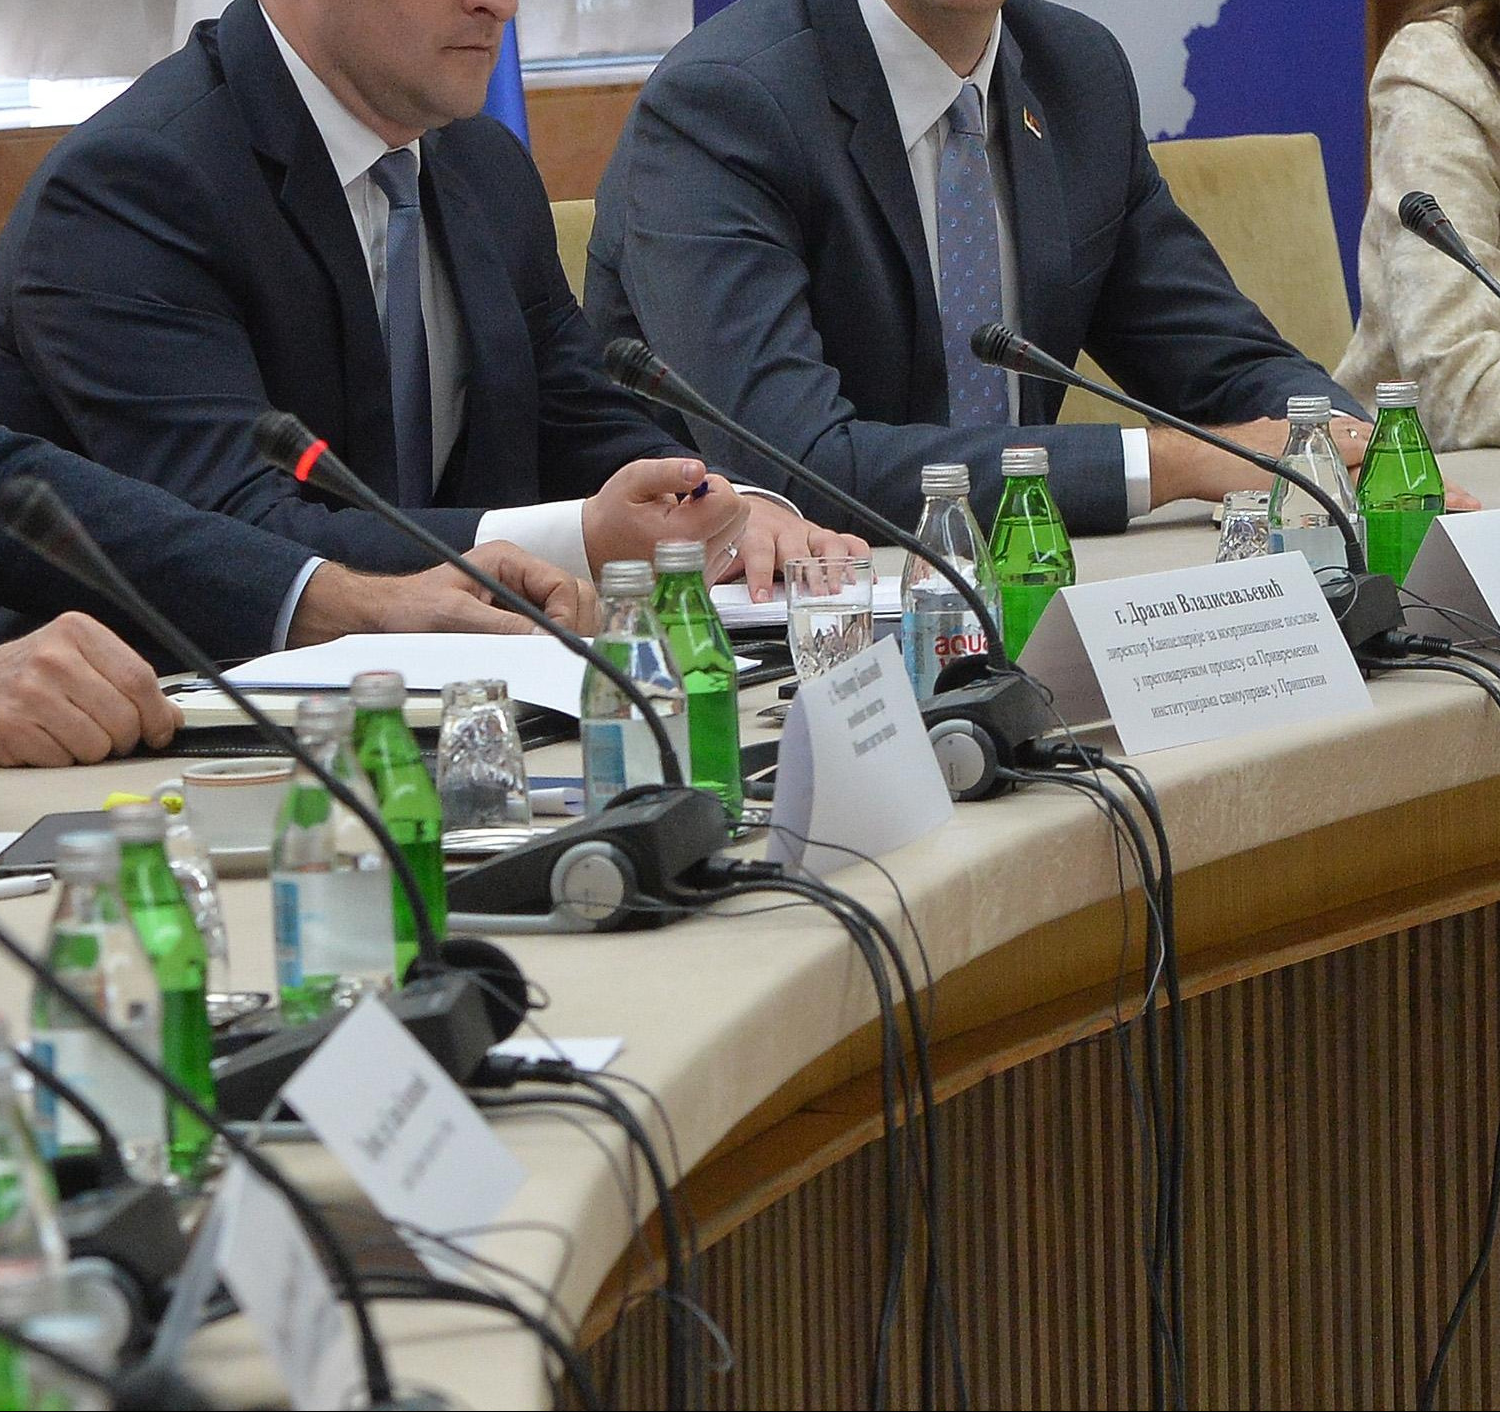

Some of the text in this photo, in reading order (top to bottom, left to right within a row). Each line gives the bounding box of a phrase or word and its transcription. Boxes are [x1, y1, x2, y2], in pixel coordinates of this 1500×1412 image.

[1114, 578, 1284, 626] г. Драган Владисављевић
[1106, 610, 1319, 662] директор Канцеларије за координационе послове
[1142, 664, 1208, 690] преговарачком
[1210, 658, 1246, 679] процесу
[1246, 656, 1258, 666] са
[1257, 643, 1319, 665] Привременим
[1151, 694, 1218, 718] институцијама
[1219, 684, 1271, 706] самоуправе
[1278, 674, 1327, 696] Приштини
